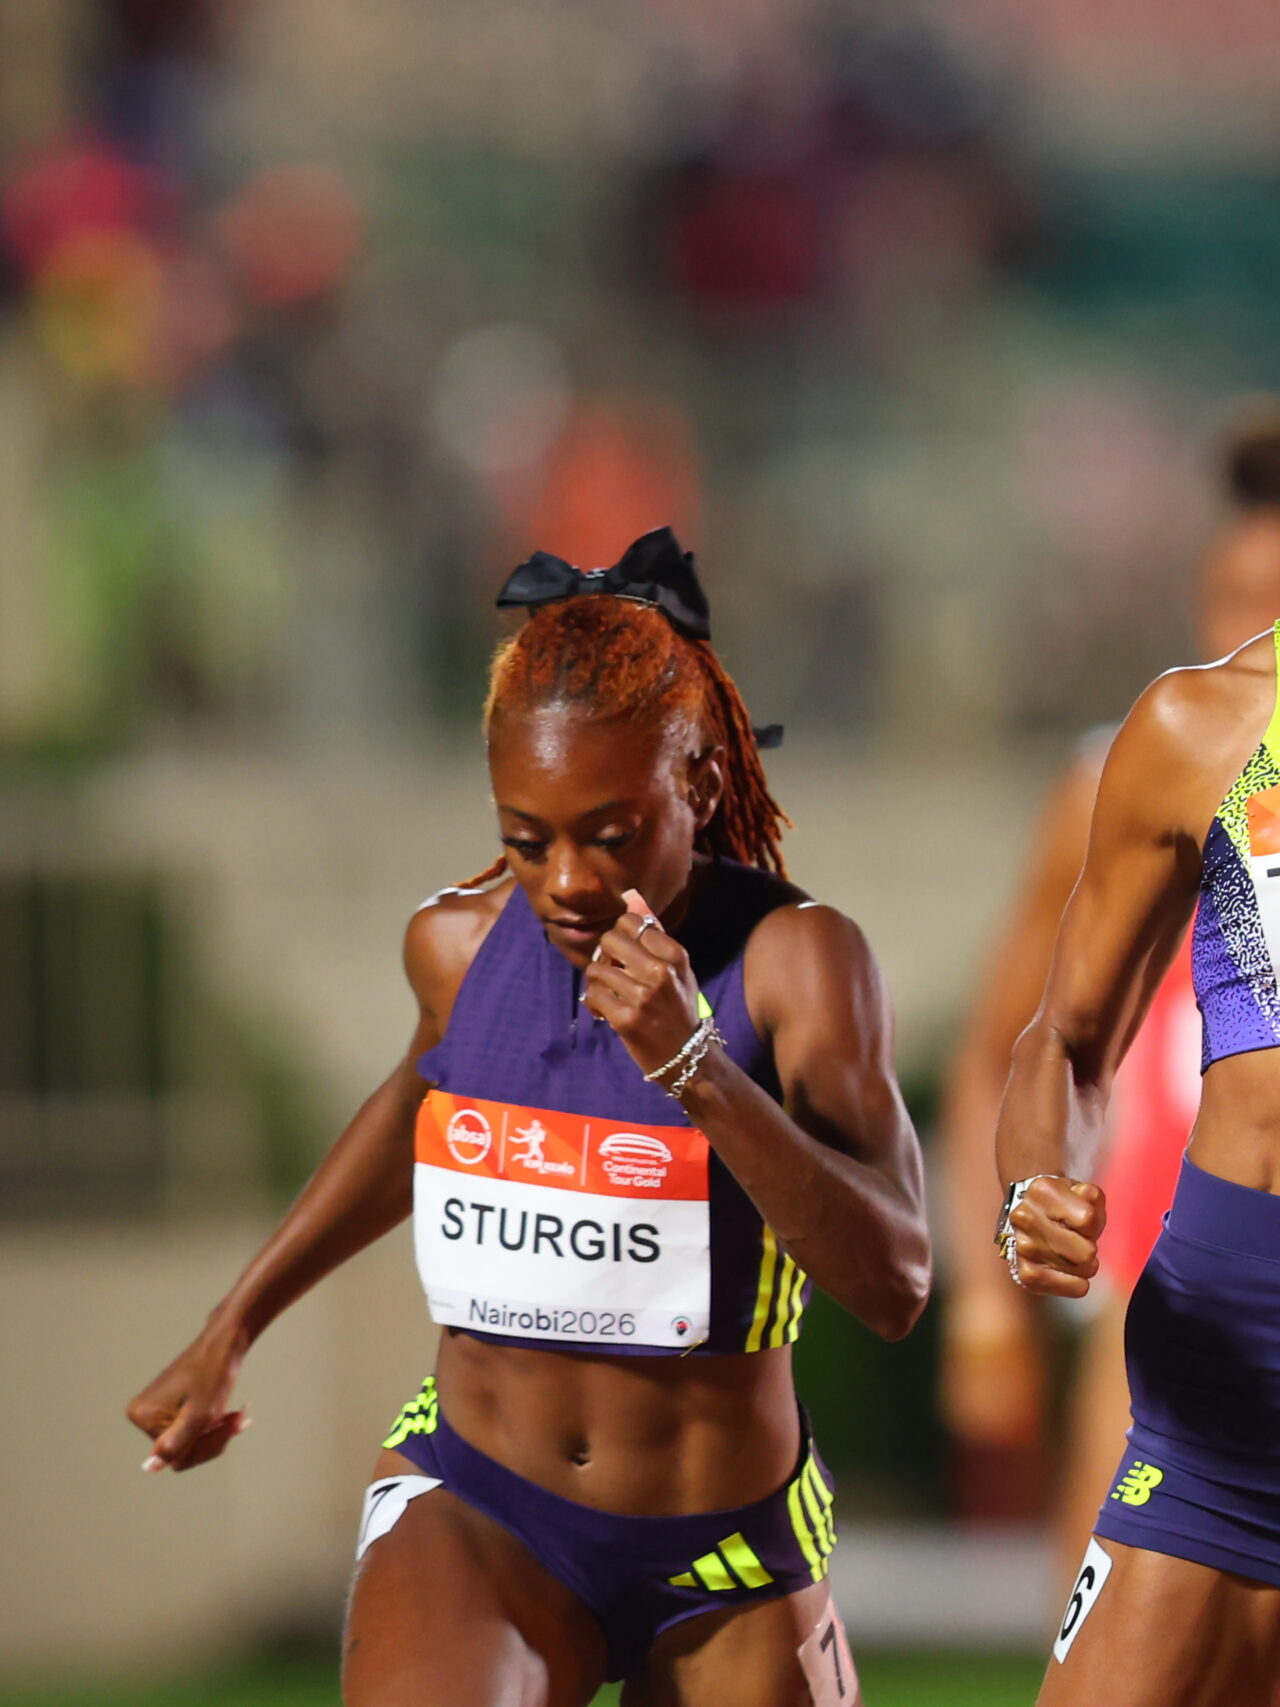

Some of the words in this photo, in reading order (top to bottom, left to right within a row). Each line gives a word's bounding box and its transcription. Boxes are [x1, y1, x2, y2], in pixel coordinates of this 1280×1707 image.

[452, 1124, 486, 1147] absa
[603, 1161, 667, 1177] Continental
[441, 1198, 661, 1263] STURGIS
[469, 1299, 636, 1336] Nairobi2026
[1060, 1565, 1096, 1641] 6
